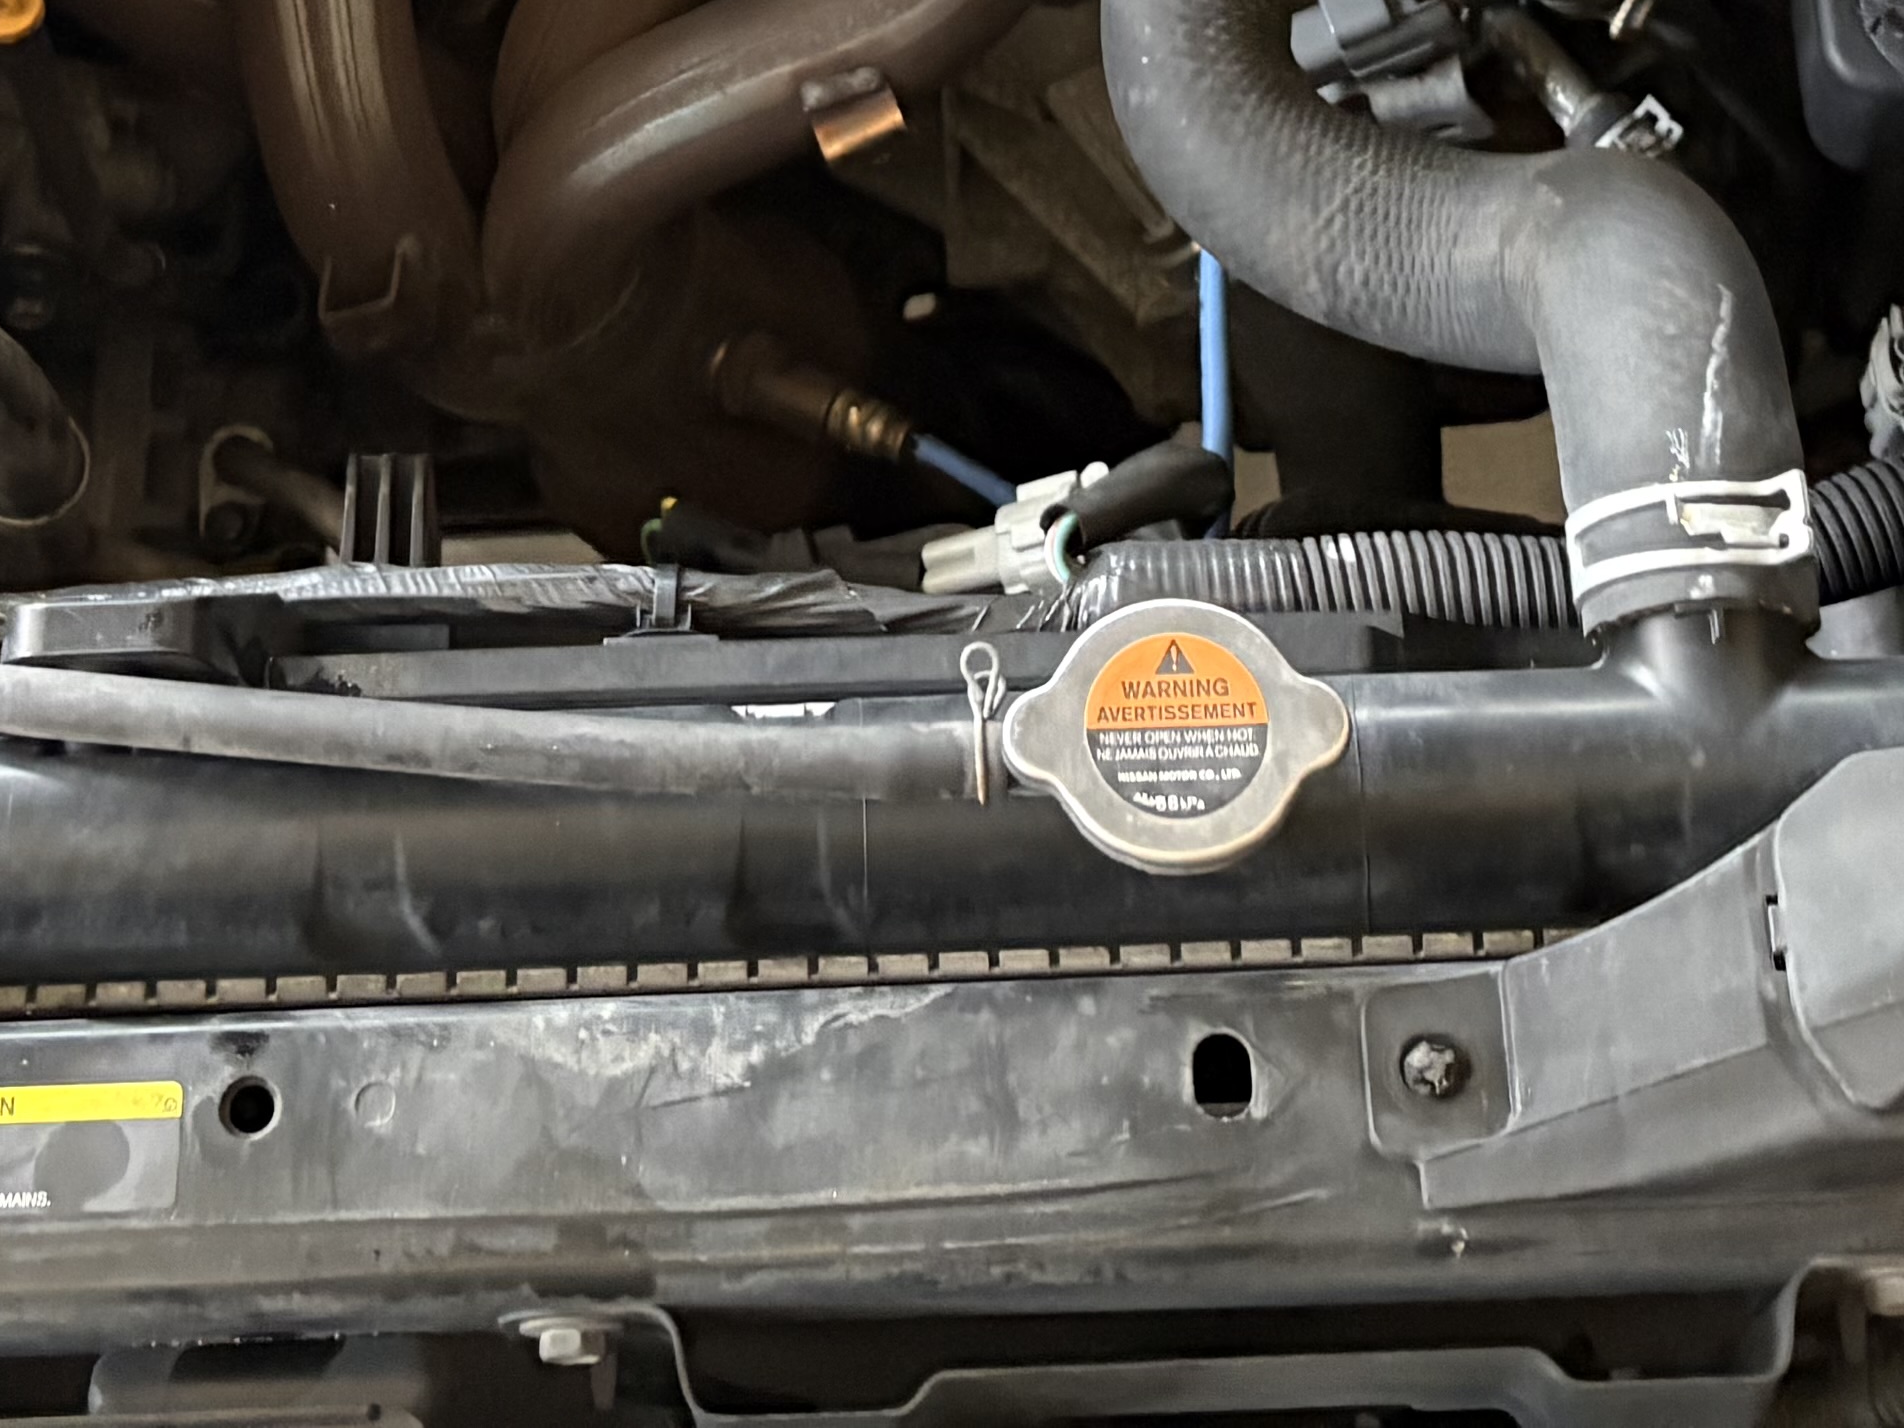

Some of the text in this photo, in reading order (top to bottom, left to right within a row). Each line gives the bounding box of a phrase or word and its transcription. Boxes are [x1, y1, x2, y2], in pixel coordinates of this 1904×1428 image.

[1121, 678, 1230, 700] WARNING
[1097, 702, 1257, 724] AVERTISSEMENT
[1099, 731, 1142, 746] NEVER
[1144, 729, 1183, 745] OPEN
[1184, 727, 1225, 744] WHEN
[1096, 747, 1113, 762] NE
[1117, 771, 1157, 783] NISSAN
[1159, 770, 1197, 782] MOTOR
